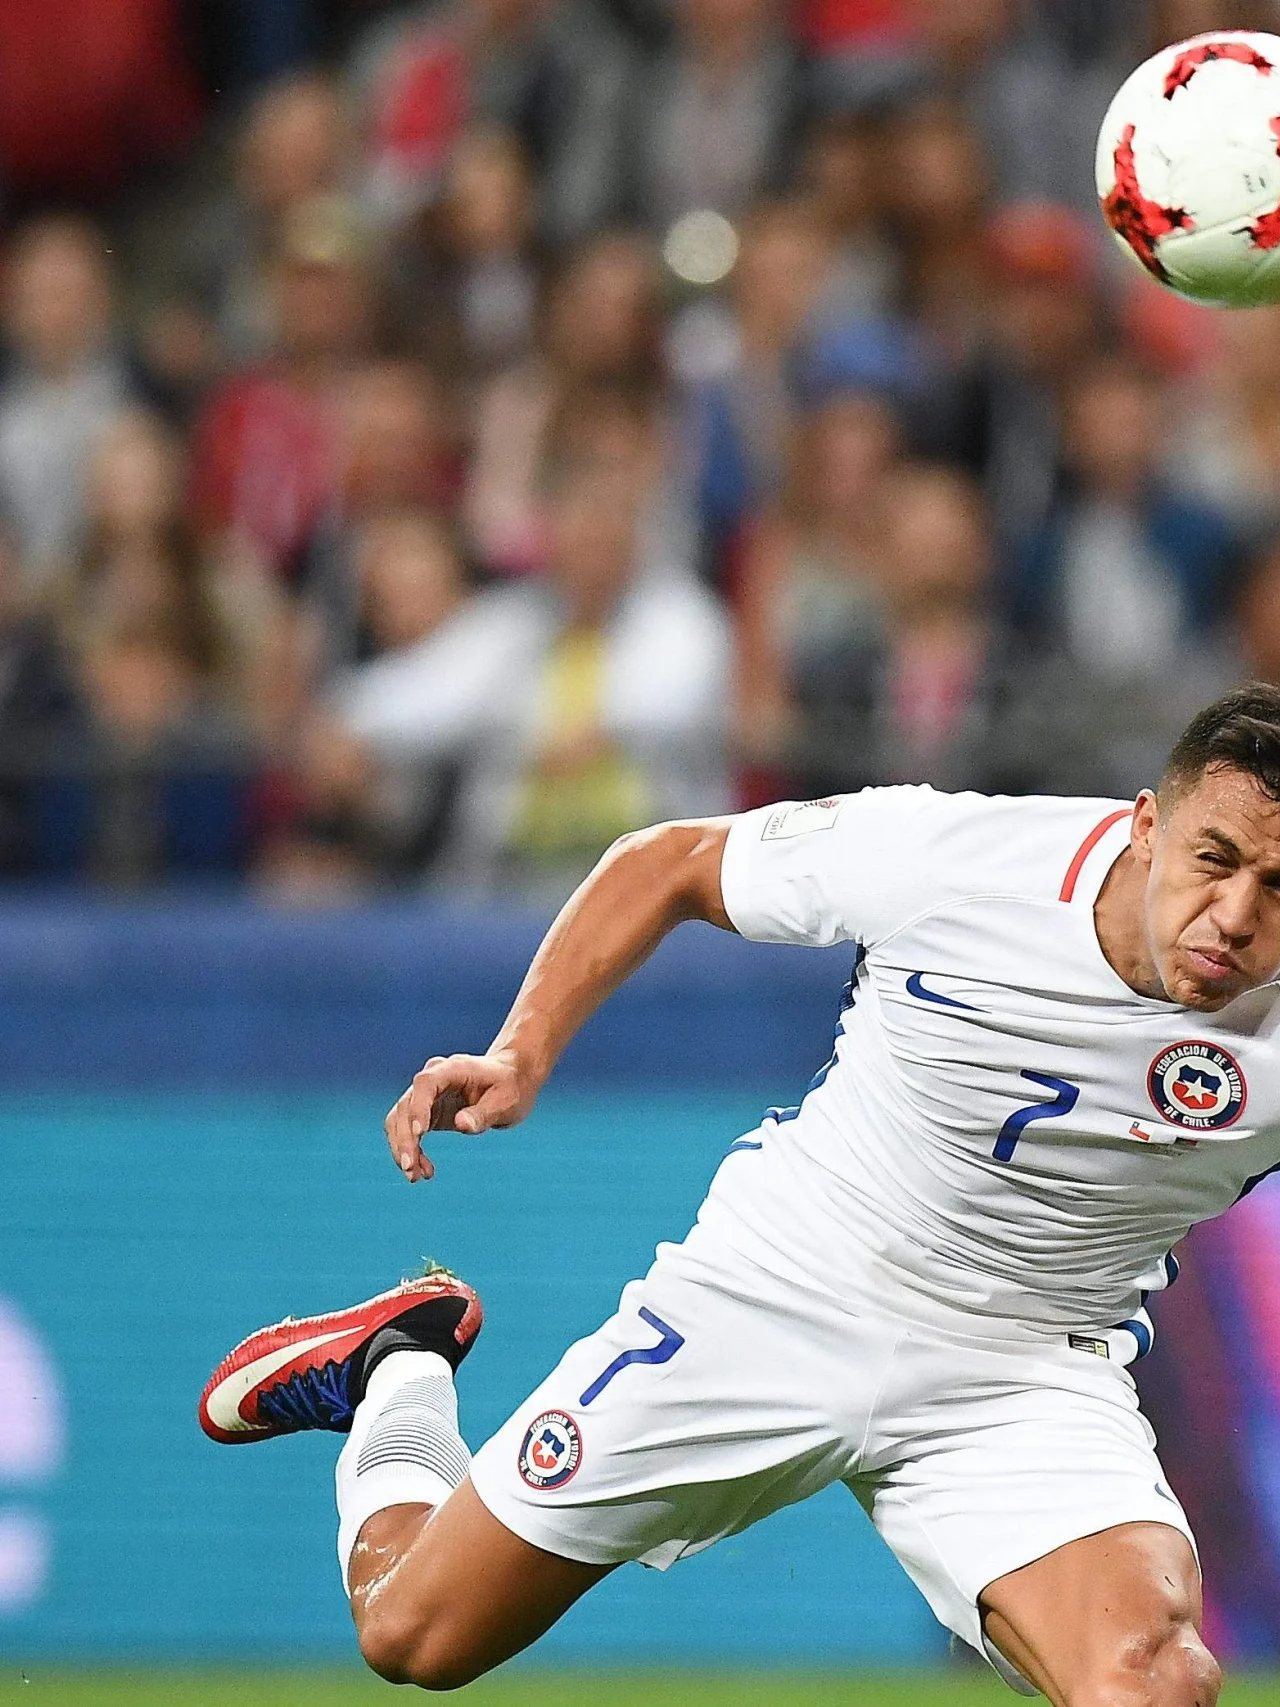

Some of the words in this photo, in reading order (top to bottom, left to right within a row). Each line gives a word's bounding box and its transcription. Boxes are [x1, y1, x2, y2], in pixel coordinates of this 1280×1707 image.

[1155, 1045, 1208, 1076] FEDERACION
[1213, 1052, 1227, 1067] DE
[1225, 1068, 1242, 1102] FUTBOL
[992, 1069, 1080, 1162] 7
[1163, 1106, 1179, 1119] DE
[1182, 1115, 1211, 1127] CHILE
[579, 1306, 685, 1407] 7
